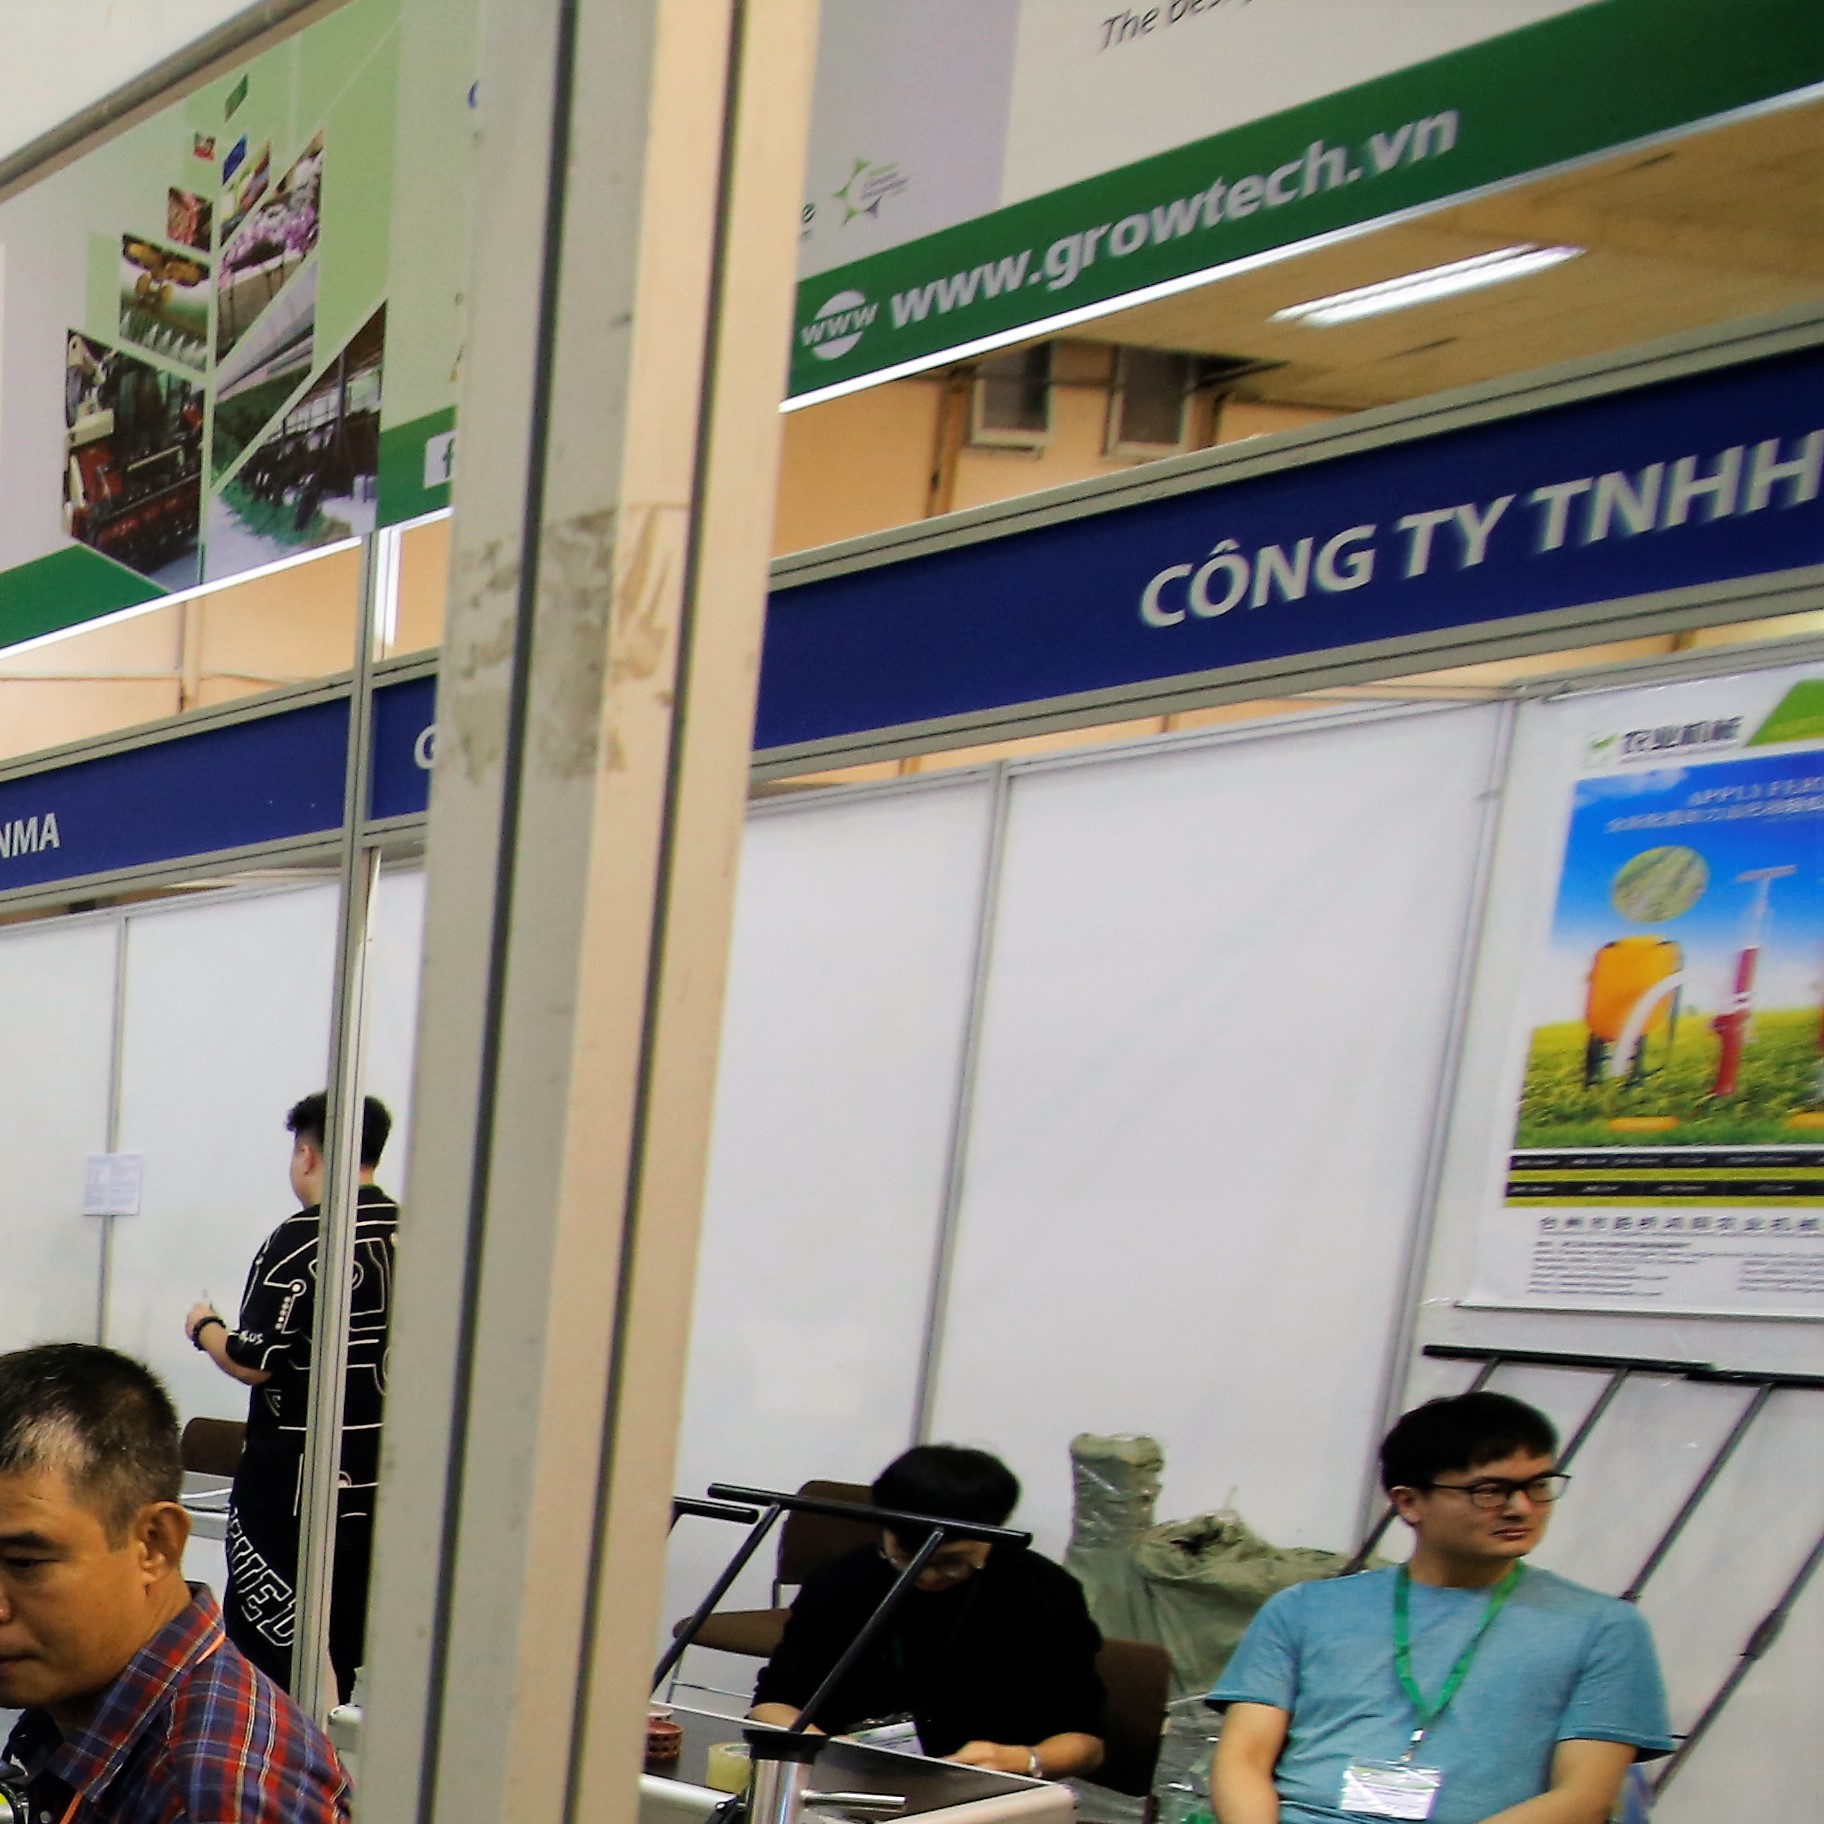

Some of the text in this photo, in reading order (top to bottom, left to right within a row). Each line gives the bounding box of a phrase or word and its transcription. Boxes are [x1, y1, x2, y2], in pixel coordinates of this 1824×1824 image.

[890, 109, 1460, 329] www.growtech.vn
[1141, 428, 1824, 630] CÔNG TY TNHH
